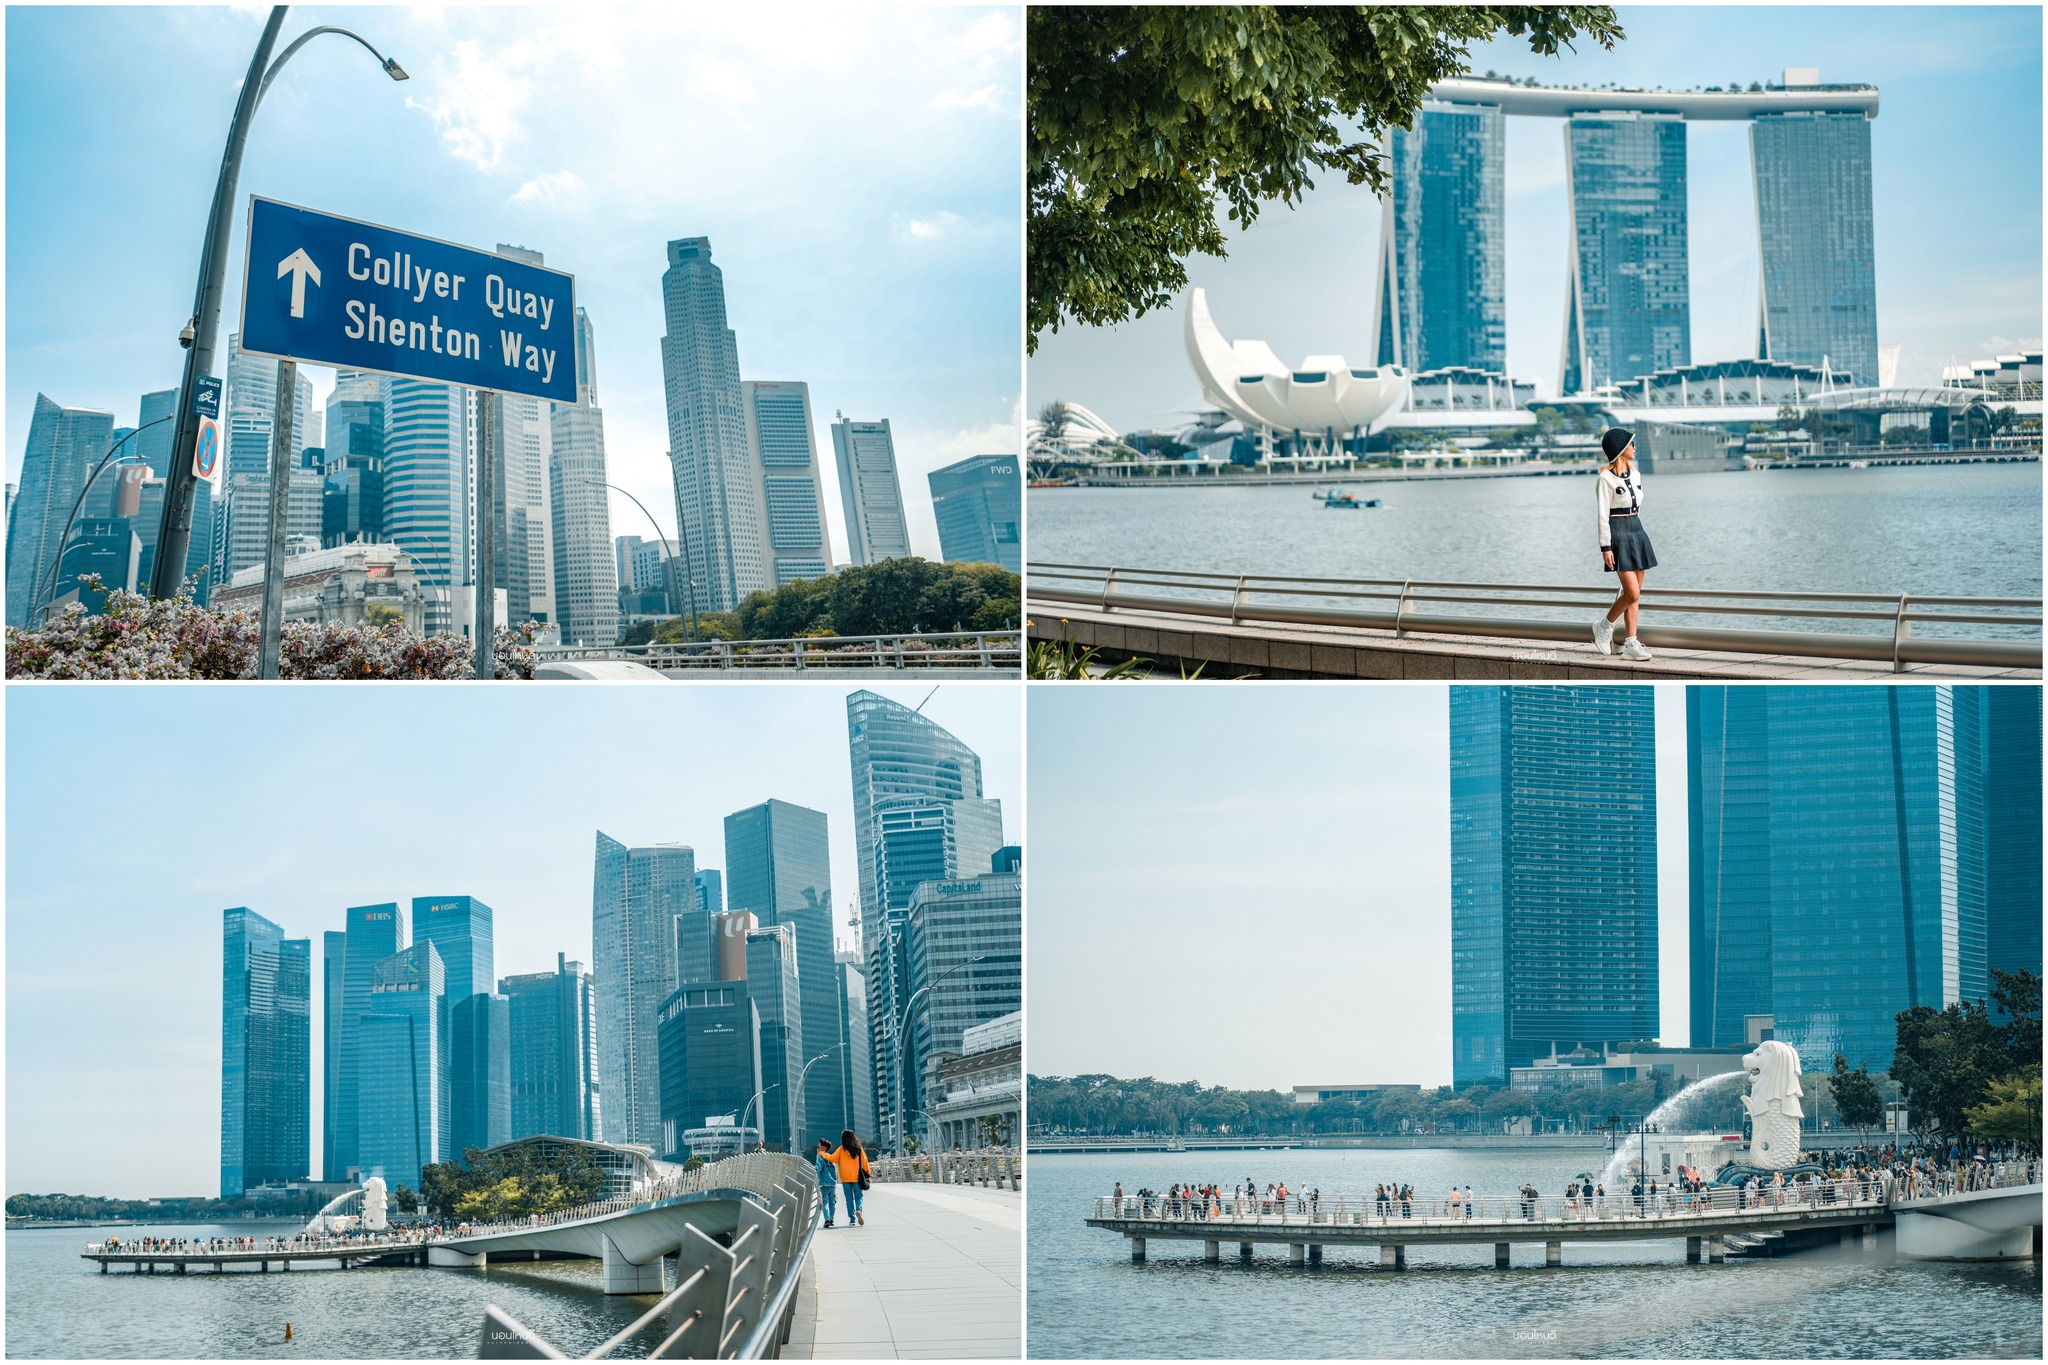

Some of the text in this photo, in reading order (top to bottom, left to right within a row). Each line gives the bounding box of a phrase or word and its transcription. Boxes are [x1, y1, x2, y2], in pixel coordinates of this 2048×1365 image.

[348, 242, 554, 330] Collyer Quay
[344, 300, 556, 384] Shenton Way
[990, 465, 1012, 474] FWD
[441, 903, 459, 911] HSBC
[373, 912, 391, 920] DBS
